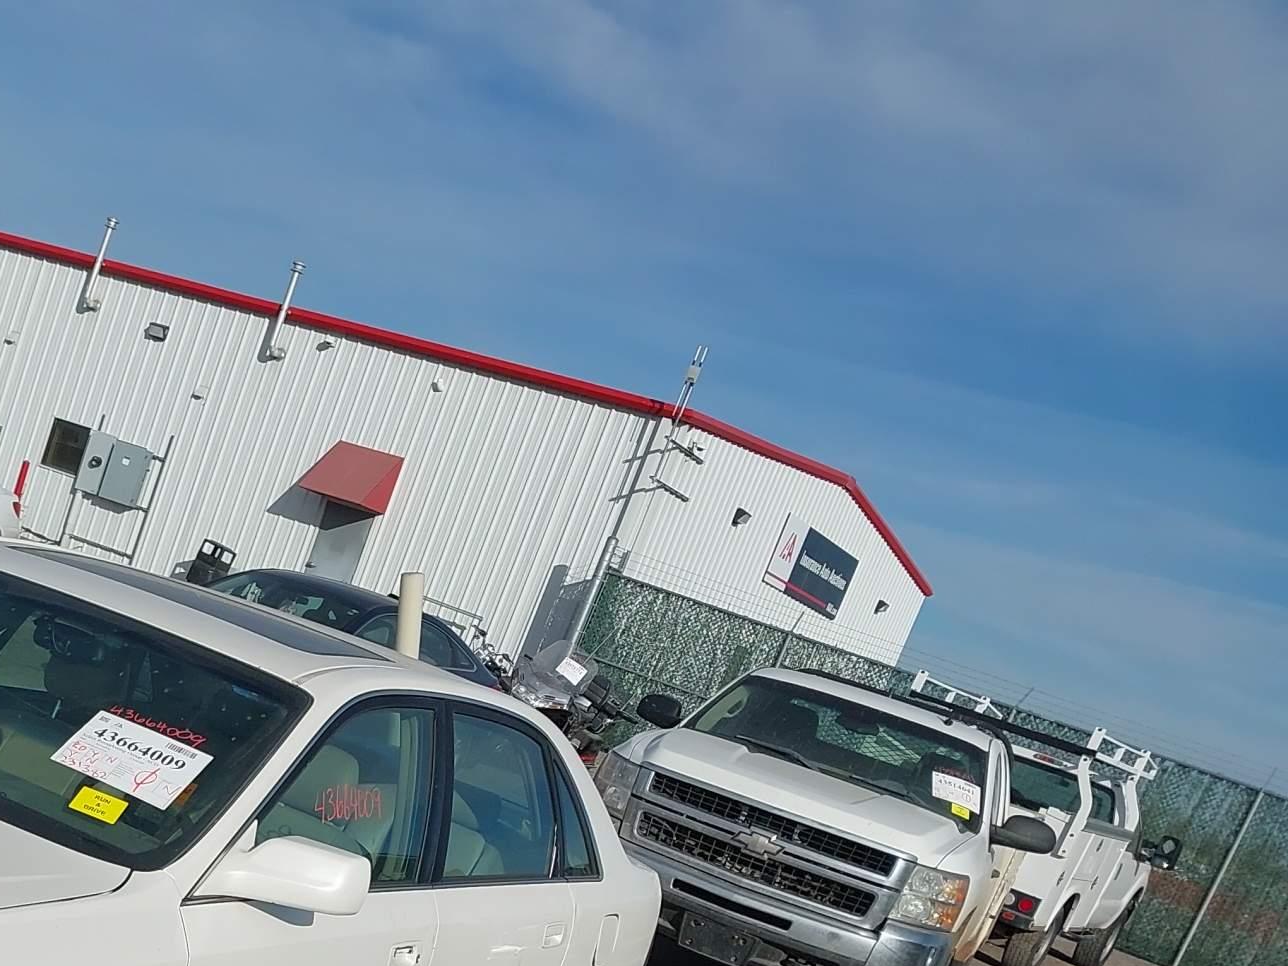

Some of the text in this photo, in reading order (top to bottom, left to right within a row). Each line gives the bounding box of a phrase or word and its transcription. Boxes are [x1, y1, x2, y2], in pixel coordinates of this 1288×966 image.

[109, 705, 208, 748] 43664009
[93, 728, 187, 770] 43664009
[83, 804, 106, 816] DRIVE
[95, 795, 111, 804] RUN
